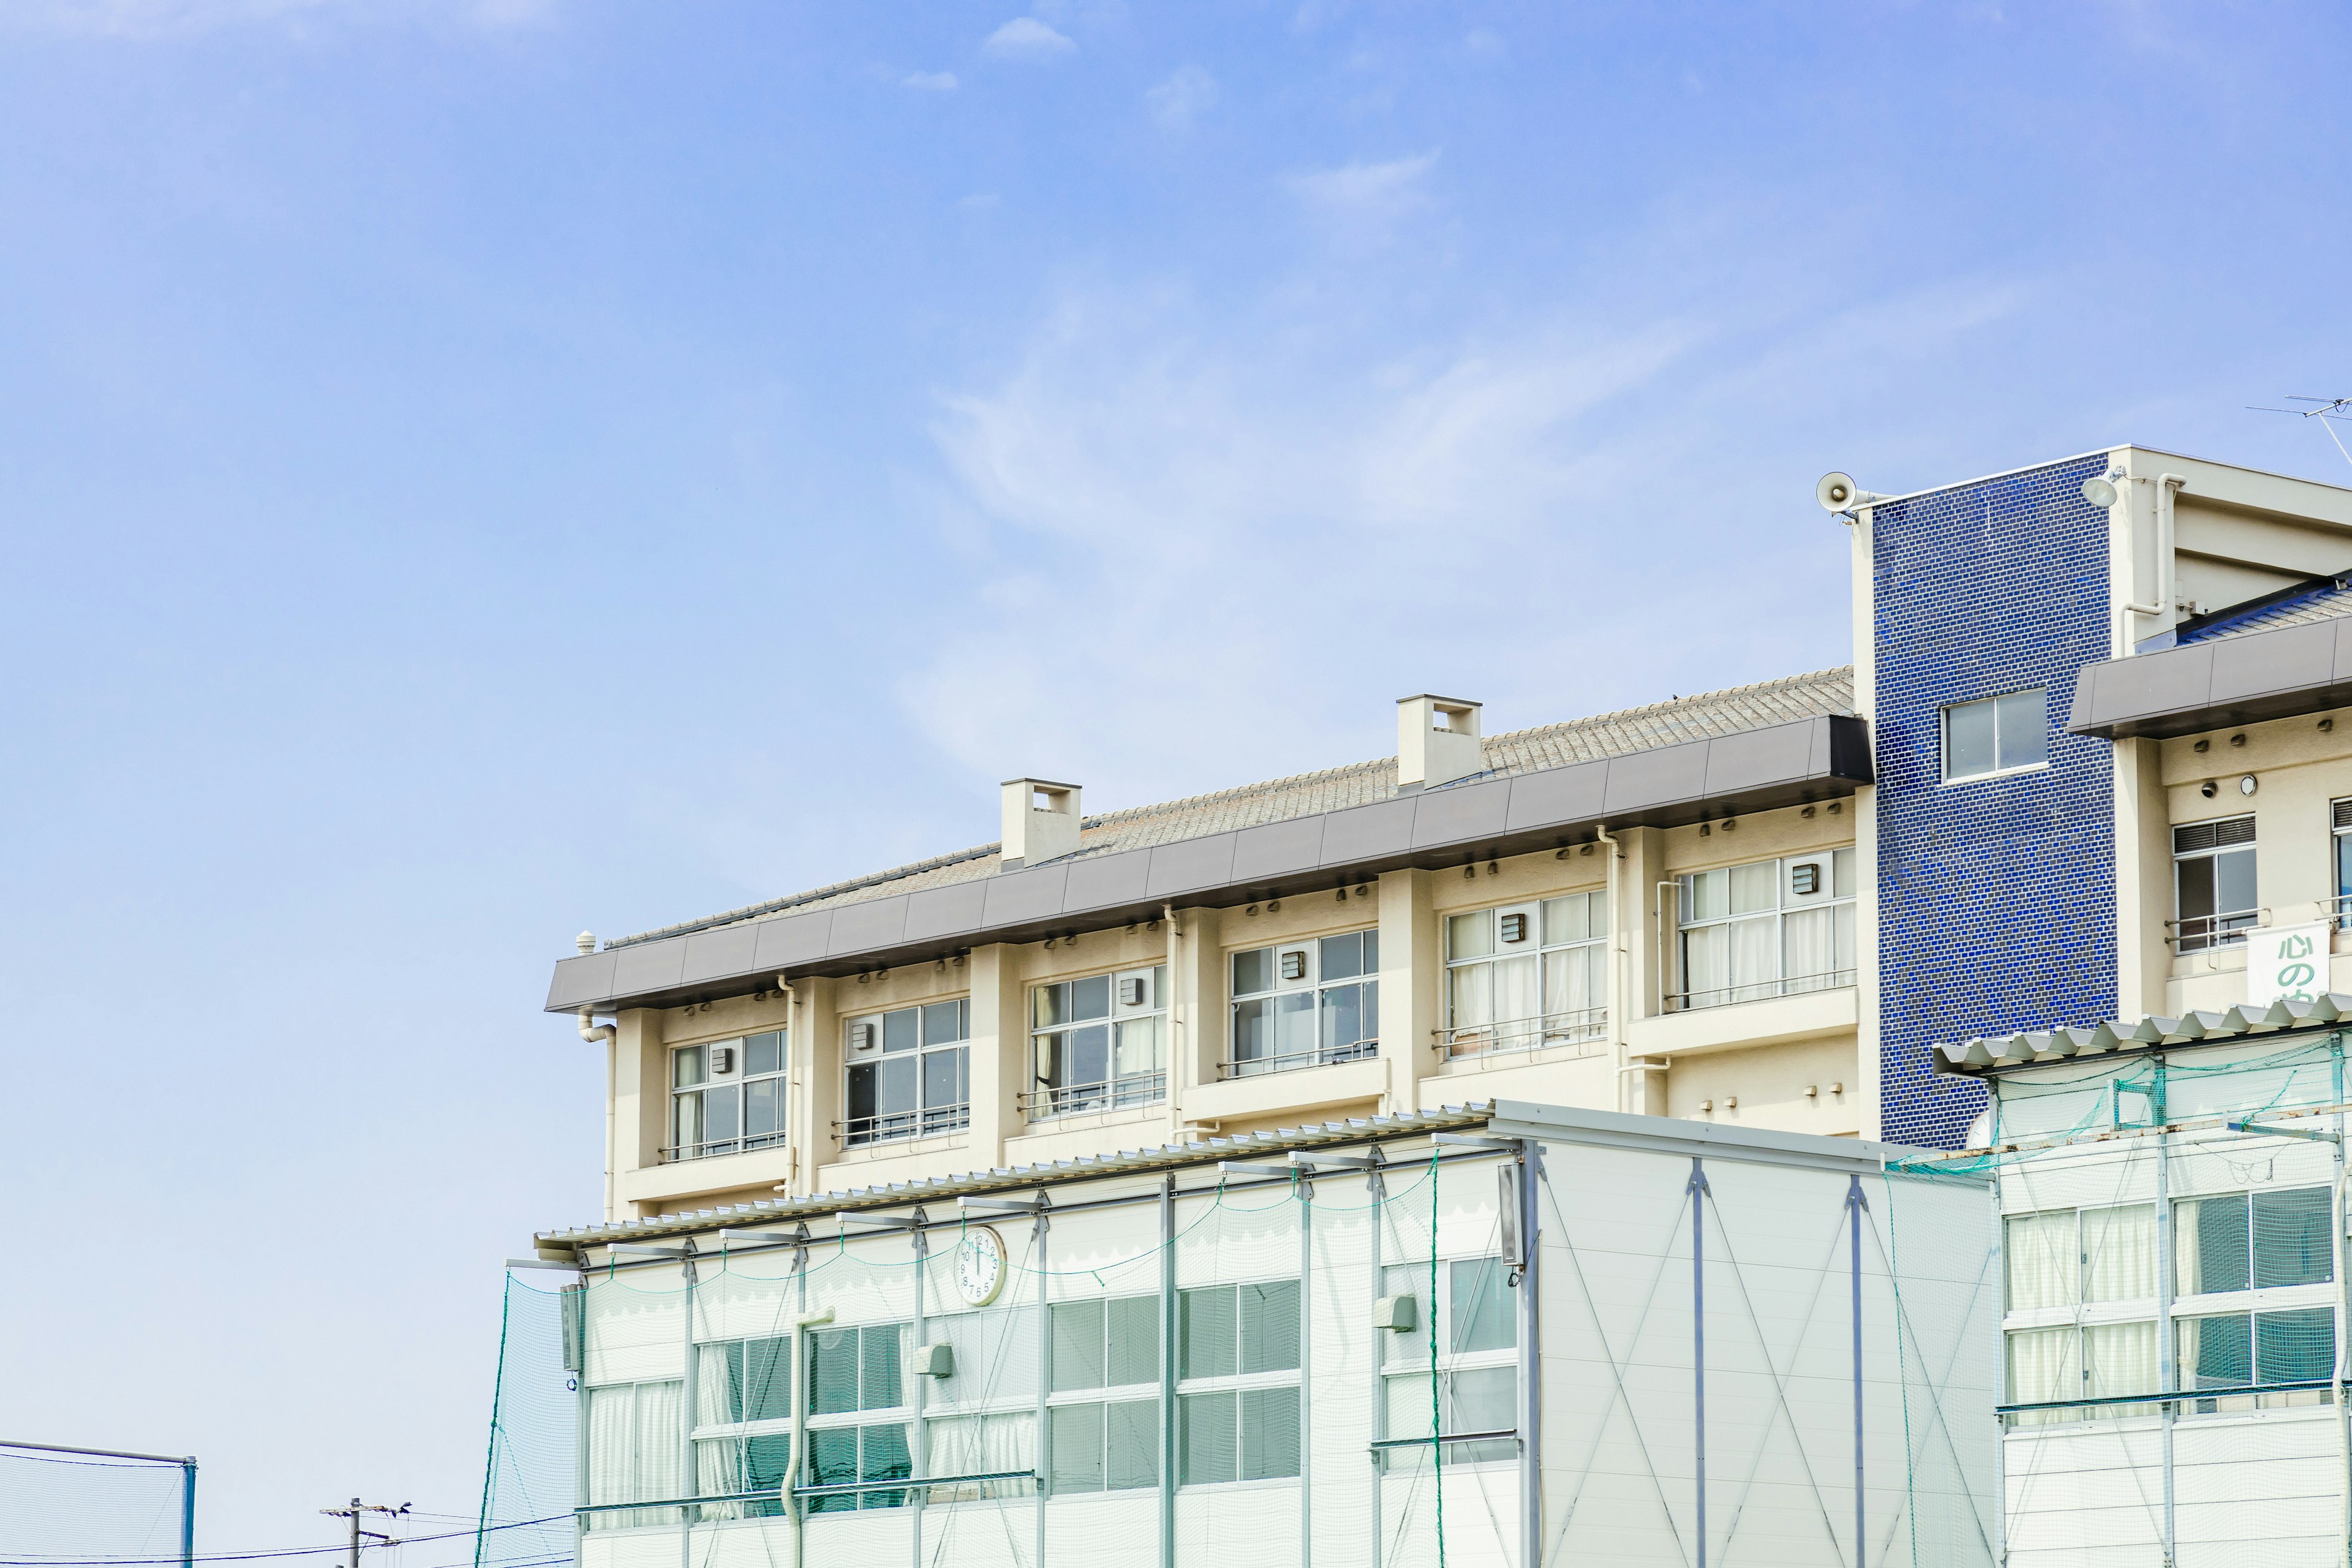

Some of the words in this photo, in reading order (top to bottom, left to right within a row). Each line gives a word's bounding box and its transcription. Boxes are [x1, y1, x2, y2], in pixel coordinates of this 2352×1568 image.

[975, 1235, 982, 1245] 12
[985, 1238, 989, 1248] 1
[968, 1241, 974, 1251] 11
[990, 1246, 995, 1256] 2
[962, 1251, 970, 1261] 10
[961, 1264, 965, 1273] 9
[993, 1259, 997, 1269] 3
[963, 1276, 968, 1286] 8
[990, 1273, 994, 1283] 4
[970, 1285, 974, 1294] 7
[976, 1287, 981, 1297] 6
[984, 1283, 989, 1292] 5
